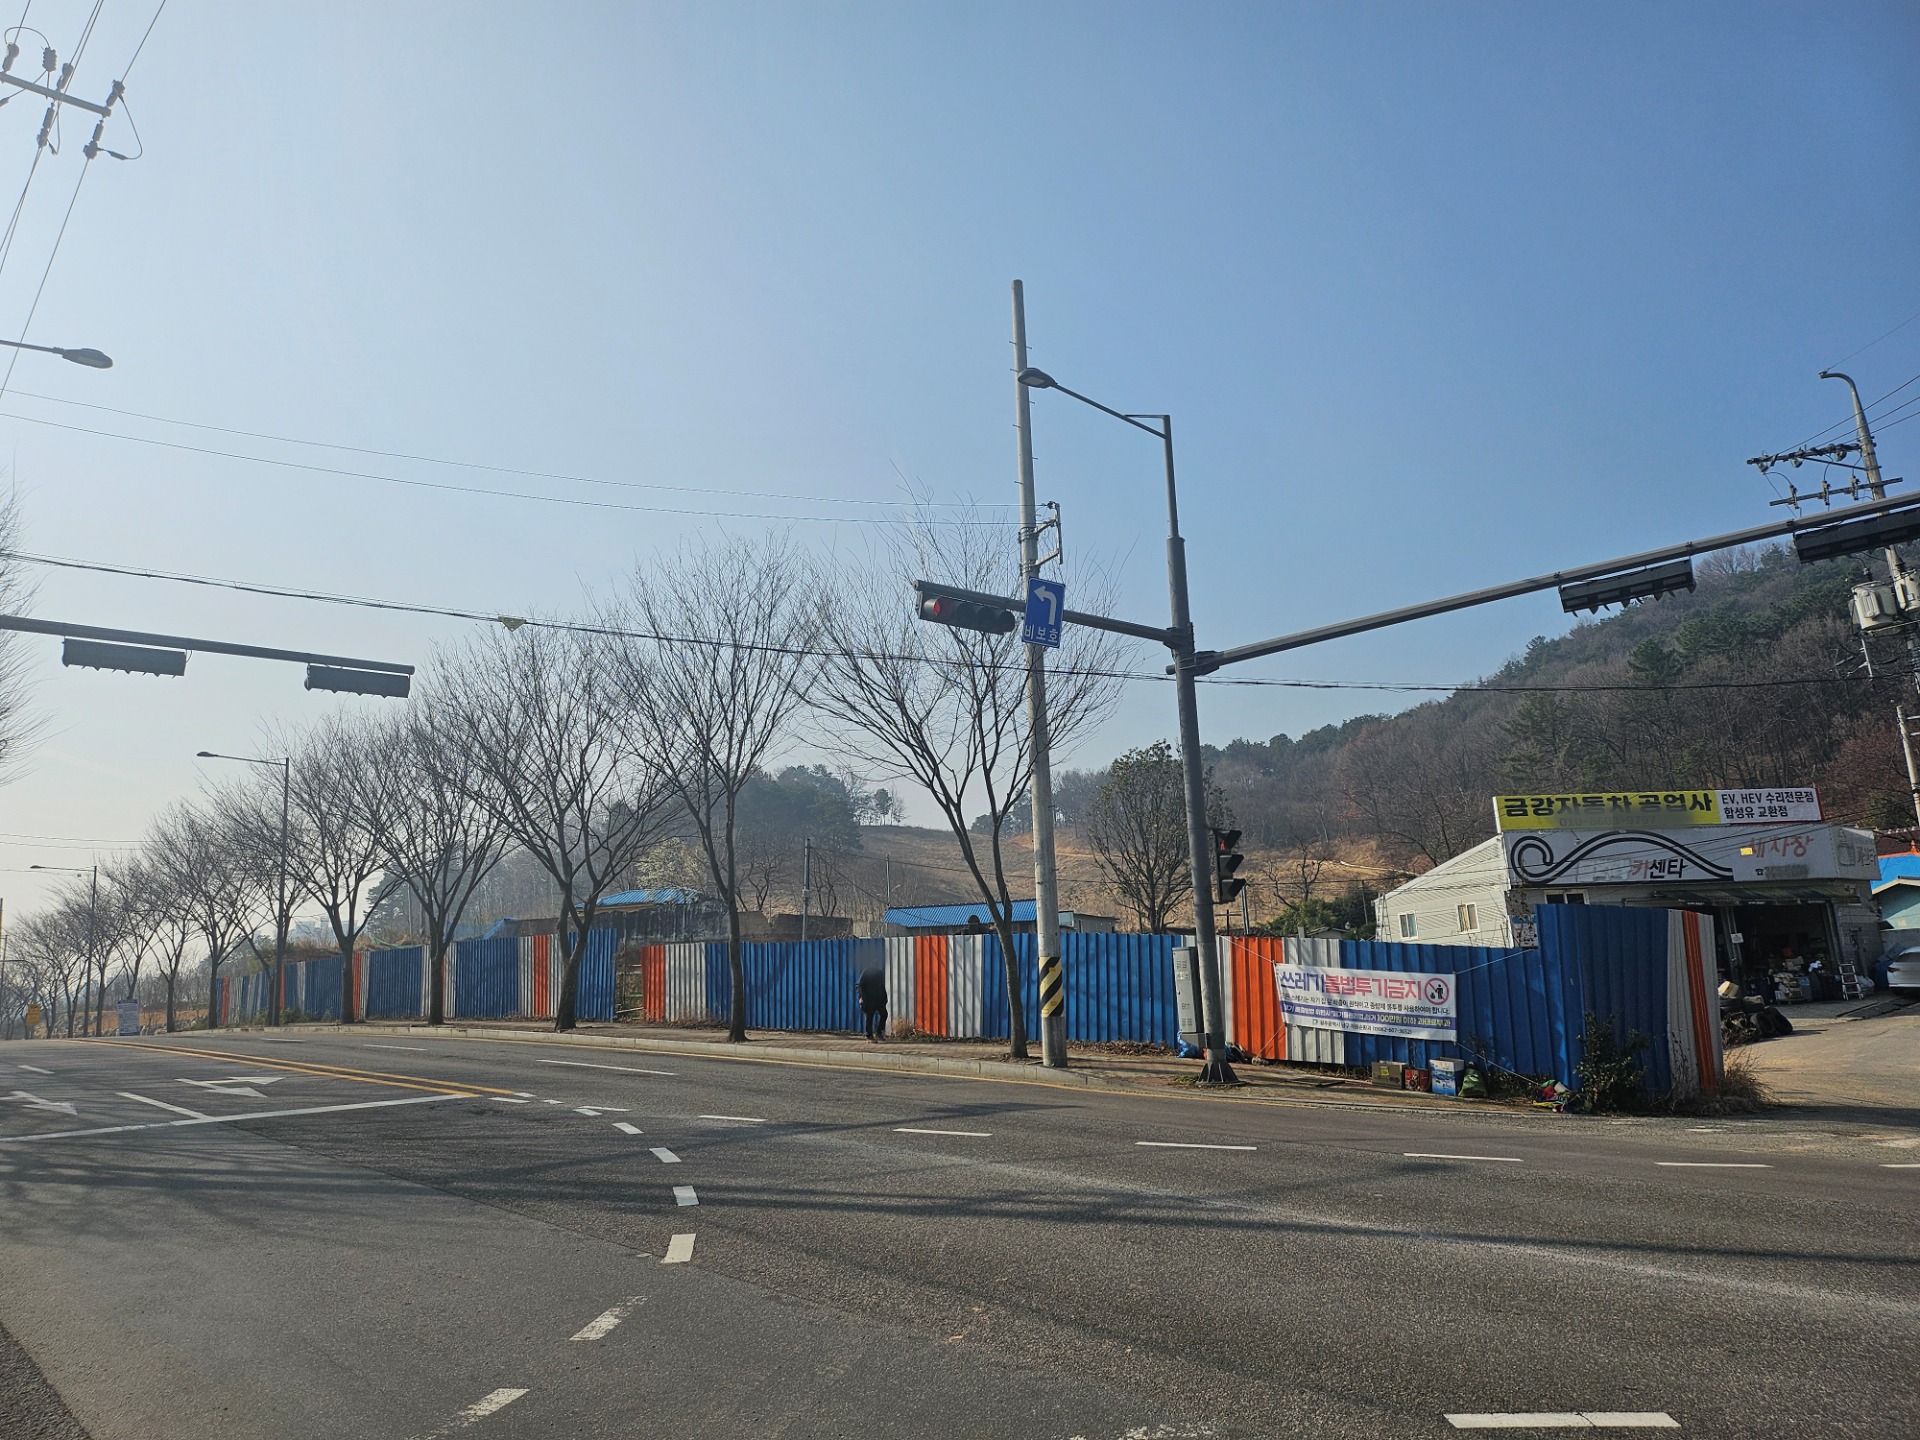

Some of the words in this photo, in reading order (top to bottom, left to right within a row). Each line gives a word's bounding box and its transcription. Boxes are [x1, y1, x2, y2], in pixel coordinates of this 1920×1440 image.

[1024, 624, 1058, 643] 비보호
[1504, 795, 1632, 817] 금강자동차
[1638, 792, 1713, 813] 공업사
[1721, 793, 1739, 805] EV,
[1741, 792, 1762, 804] HEV
[1765, 791, 1814, 804] 수리전문점
[1724, 806, 1755, 819] 합성유
[1757, 805, 1789, 818] 교환점
[1632, 859, 1689, 879] 카센타
[1403, 1015, 1416, 1024] 이하
